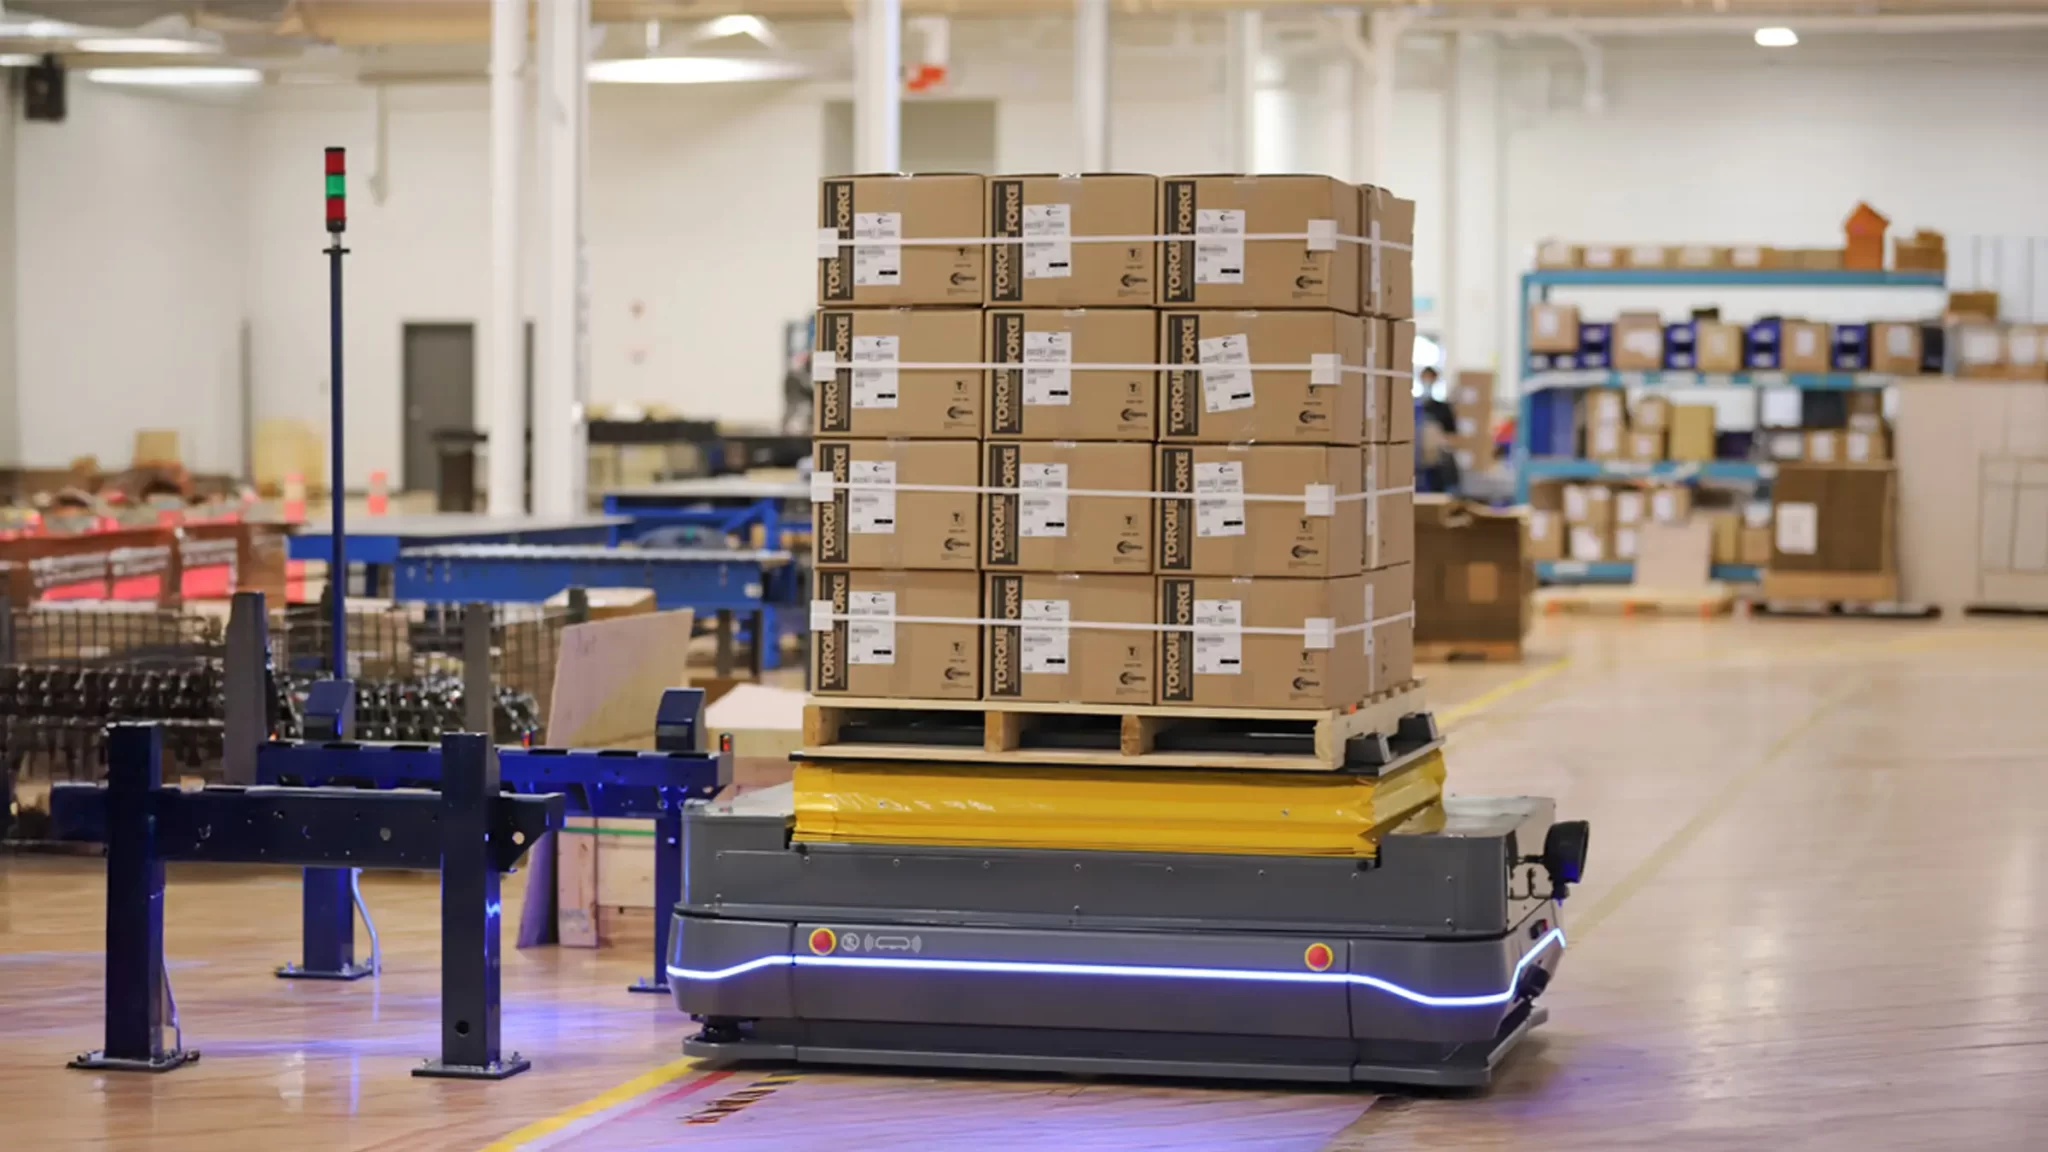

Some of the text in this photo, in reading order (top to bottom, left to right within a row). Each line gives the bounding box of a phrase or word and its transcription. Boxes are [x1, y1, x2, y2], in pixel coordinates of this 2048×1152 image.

[837, 184, 850, 231] FORCE
[1006, 184, 1019, 231] FORCE
[1179, 184, 1192, 231] FORCE
[825, 382, 838, 428] TORQ
[1002, 448, 1015, 488] ORCE
[1175, 452, 1188, 492] ORCE
[822, 502, 835, 560] TORQU
[992, 494, 1005, 561] TORQUE
[1165, 499, 1178, 565] TORQUE
[833, 575, 845, 613] ORCE
[1005, 580, 1018, 619] ORCE
[1177, 583, 1190, 624] ORCE
[995, 626, 1008, 692] TORQUE
[1166, 631, 1179, 698] TORQUE
